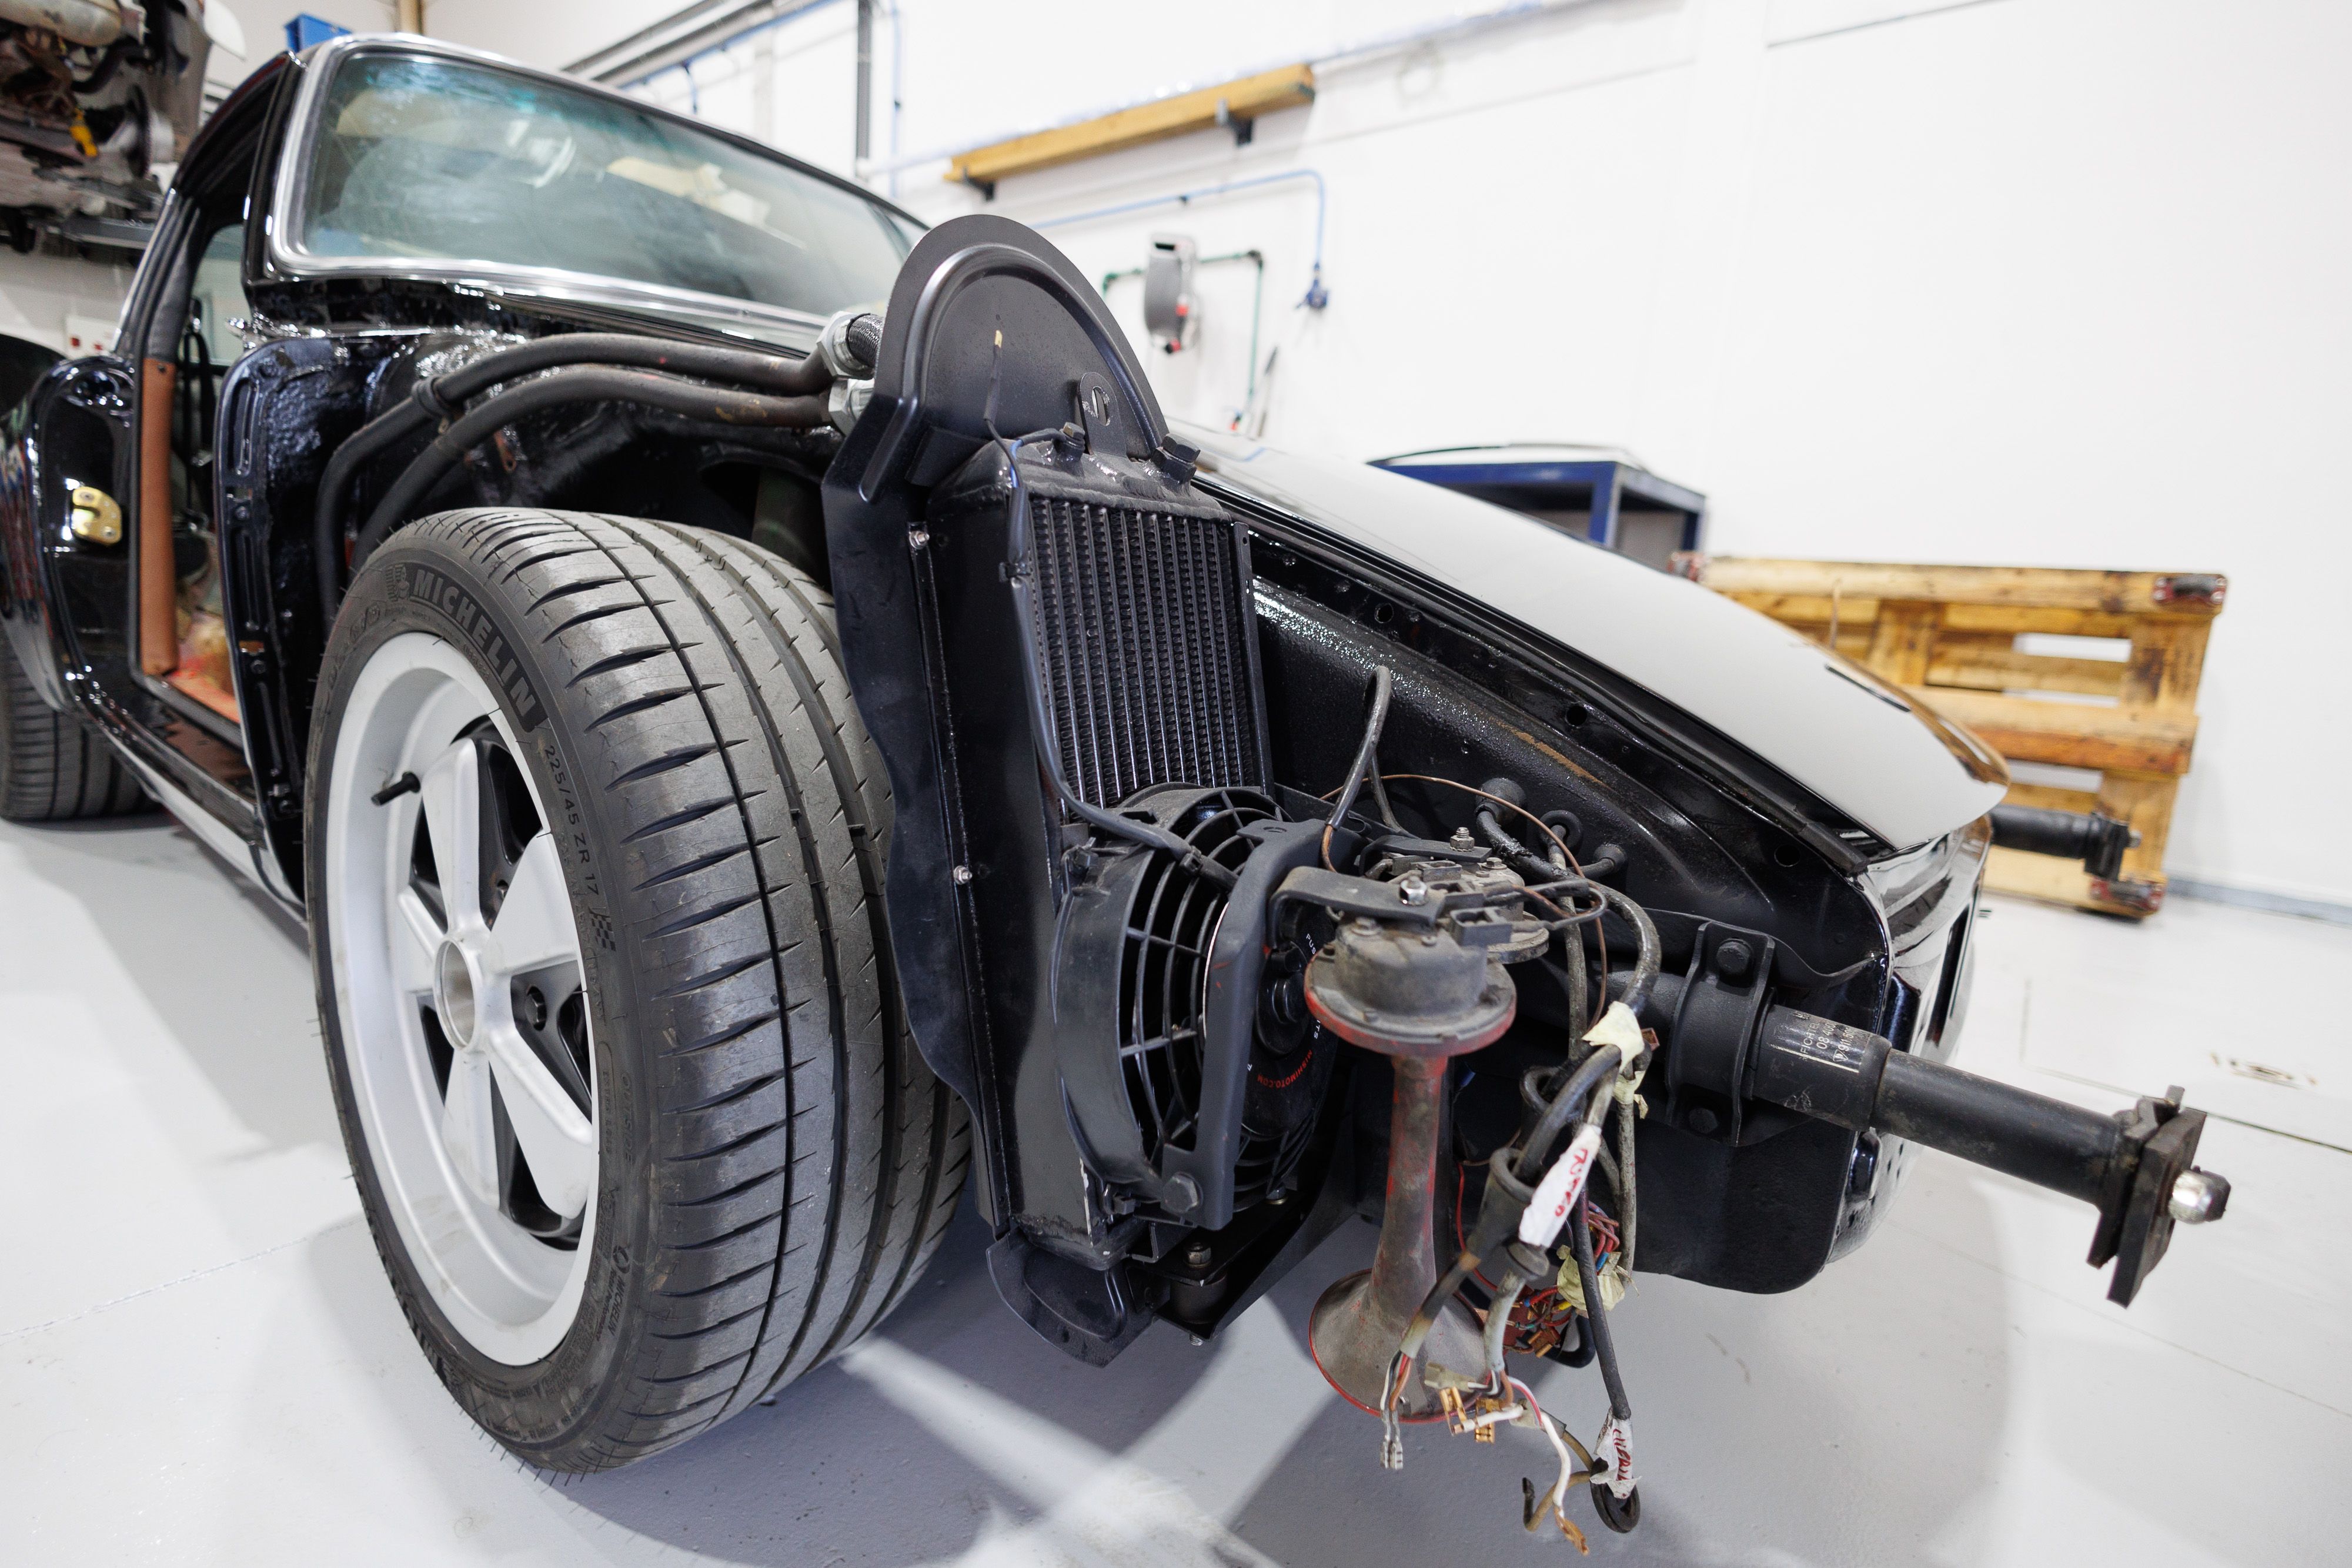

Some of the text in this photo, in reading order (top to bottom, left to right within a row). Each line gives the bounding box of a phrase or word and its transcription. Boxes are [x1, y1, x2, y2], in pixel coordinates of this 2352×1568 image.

[413, 569, 536, 717] MICHELIN
[544, 745, 580, 825] 225/45
[574, 833, 590, 864] ZR
[585, 873, 599, 895] 17
[1800, 1022, 1820, 1054] FICHTEL
[1816, 1036, 1830, 1049] 08
[1257, 1049, 1313, 1088] MISHIMOTO.COM
[607, 1275, 625, 1336] MICHELIN
